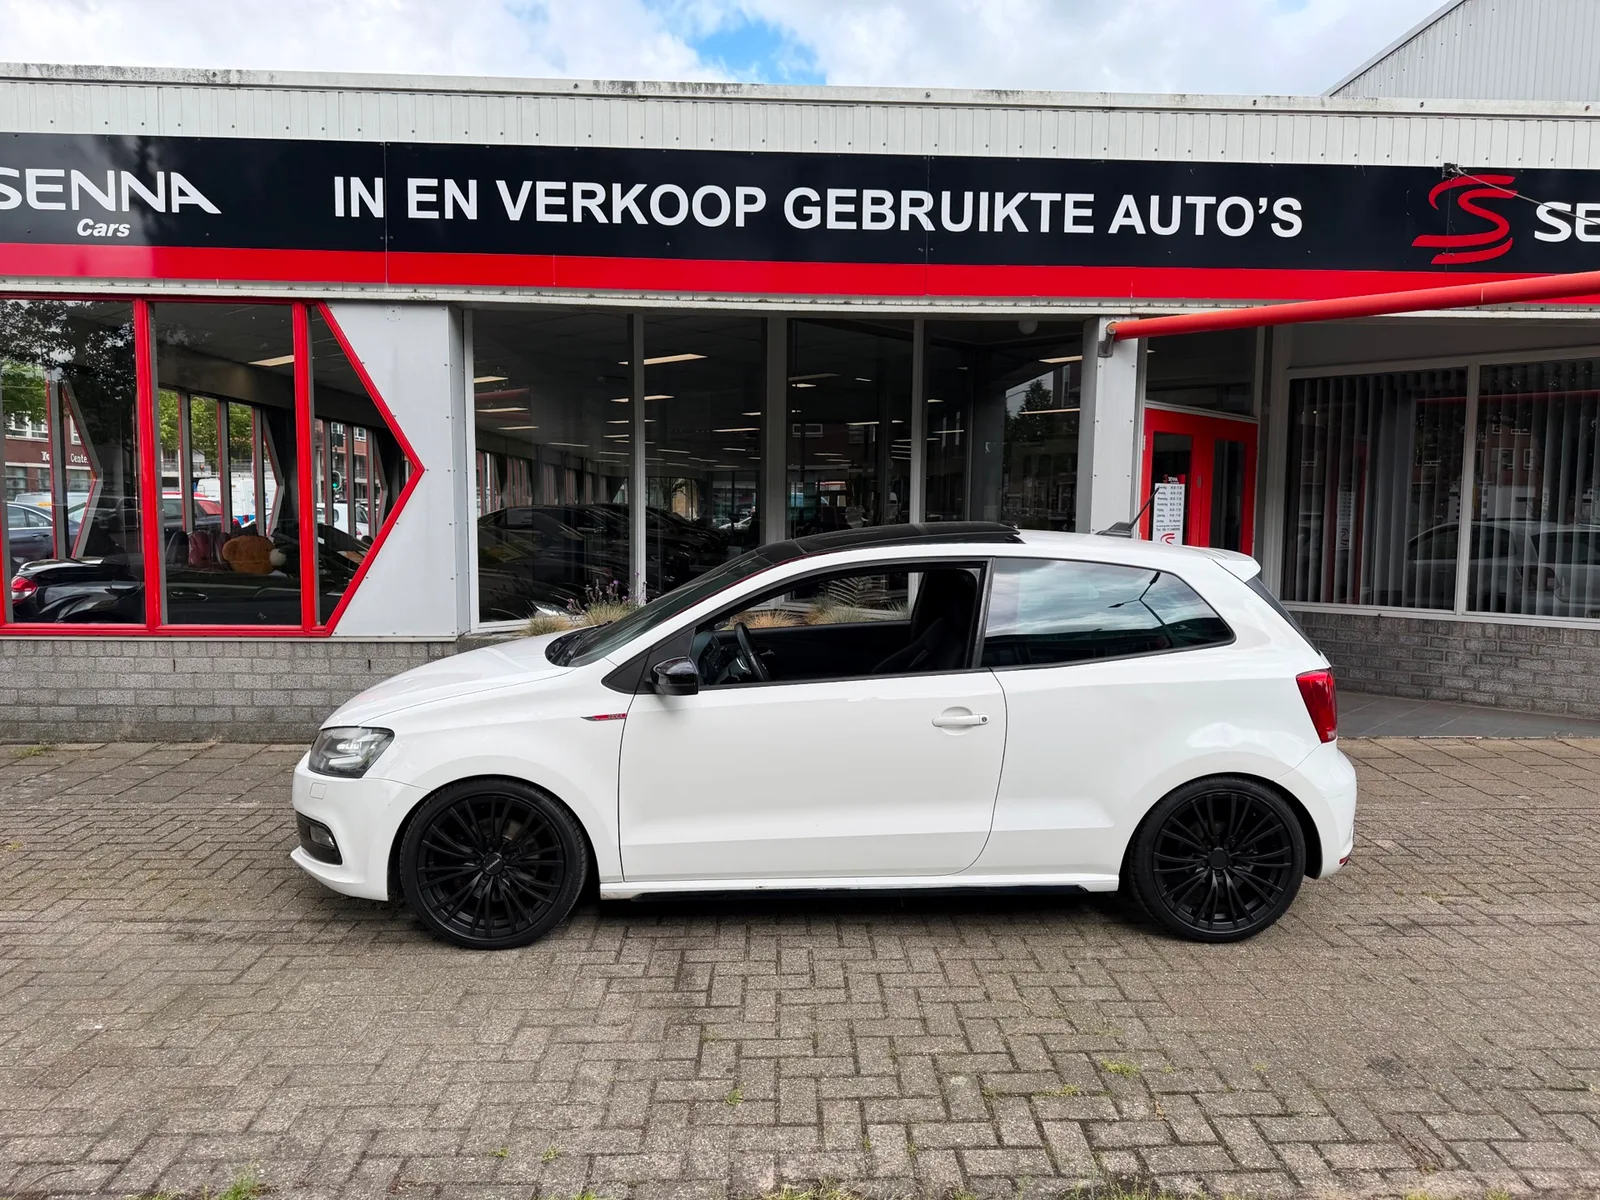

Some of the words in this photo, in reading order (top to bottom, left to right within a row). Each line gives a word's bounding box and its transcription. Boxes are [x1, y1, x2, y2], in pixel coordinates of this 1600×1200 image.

[0, 166, 222, 214] SENNA
[334, 176, 383, 218] IN
[407, 177, 478, 220] EN
[496, 180, 767, 227] VERKOOP
[783, 187, 1095, 234] GEBRUIKTE
[1107, 194, 1303, 238] AUTO'S
[76, 218, 131, 238] Cars
